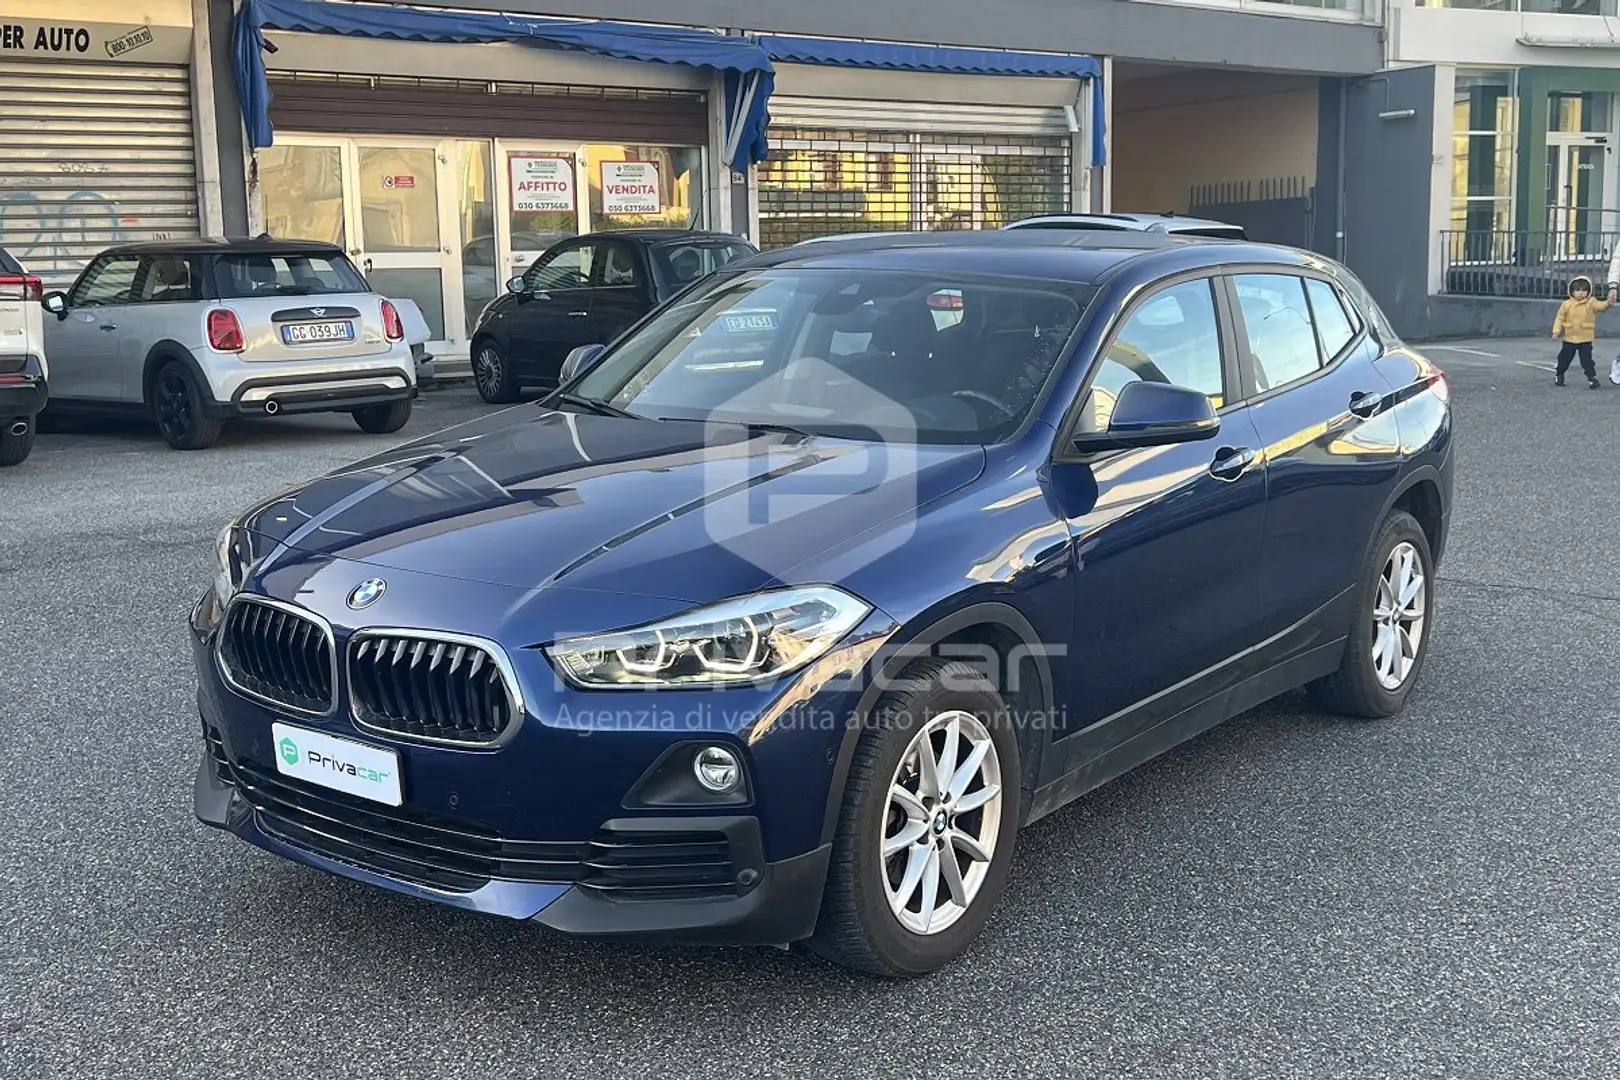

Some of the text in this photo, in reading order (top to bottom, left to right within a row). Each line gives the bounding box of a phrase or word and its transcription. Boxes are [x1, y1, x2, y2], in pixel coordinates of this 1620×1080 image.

[0, 25, 90, 52] ER AUTO
[518, 181, 567, 192] AFFITTO
[606, 185, 656, 195] VENDITA
[291, 326, 307, 340] GG
[308, 751, 389, 784] Privacar
